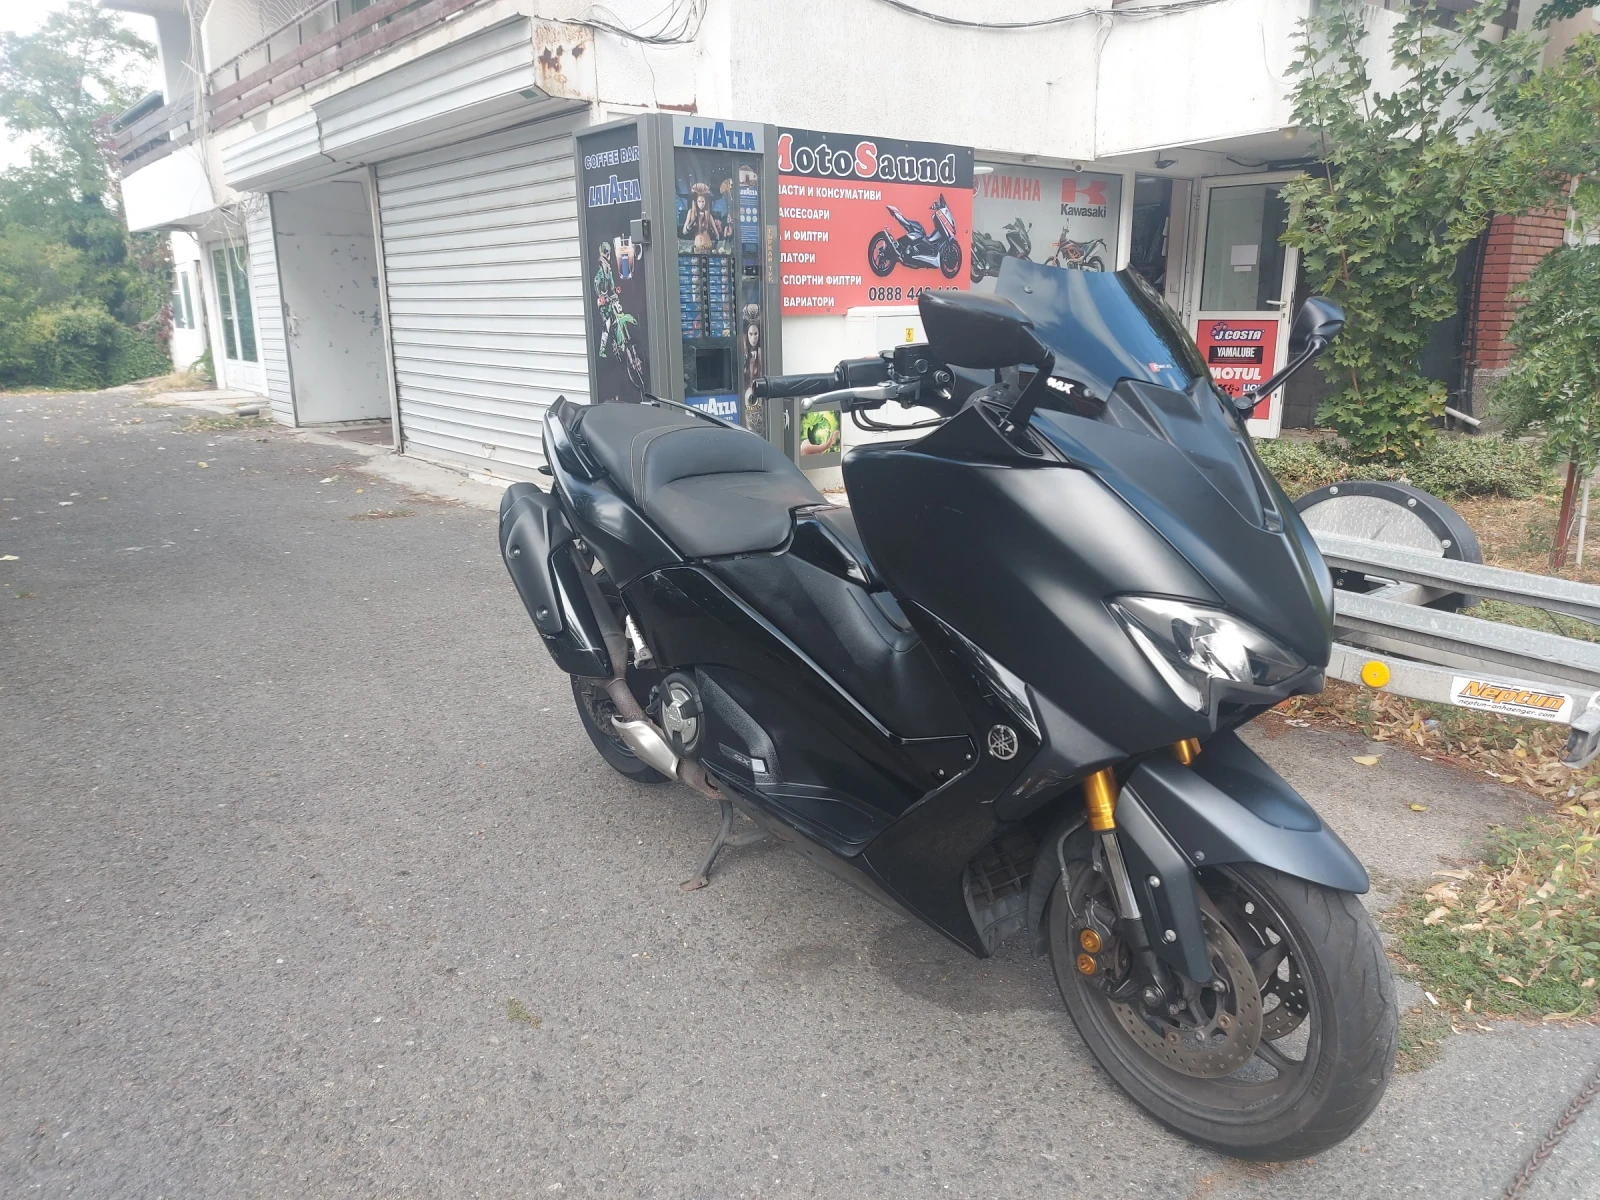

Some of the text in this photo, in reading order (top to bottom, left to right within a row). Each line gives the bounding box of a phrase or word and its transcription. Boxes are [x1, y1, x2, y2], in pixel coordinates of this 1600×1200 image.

[683, 122, 756, 152] LAVAZZA
[584, 145, 640, 170] COFFEE BAR
[588, 174, 642, 208] LAVAZZA
[807, 186, 814, 197] И
[816, 187, 882, 201] КОНСУМАТИВИ
[982, 173, 1041, 202] YAMAHA
[779, 206, 831, 220] АКСЕСОАРИ
[1060, 203, 1107, 218] Kawasaki
[784, 230, 791, 241] И
[793, 230, 830, 242] ФИЛТРИ
[783, 274, 862, 286] СПОРТНИ ФИЛТРИ
[783, 296, 836, 307] ВАРИАТОРИ
[868, 286, 902, 302] 0888
[1216, 346, 1257, 358] YAMALUBE
[1209, 366, 1262, 381] MOTUL
[1459, 680, 1566, 711] Neptun
[1458, 698, 1556, 719] neptun-anhaenger.com
